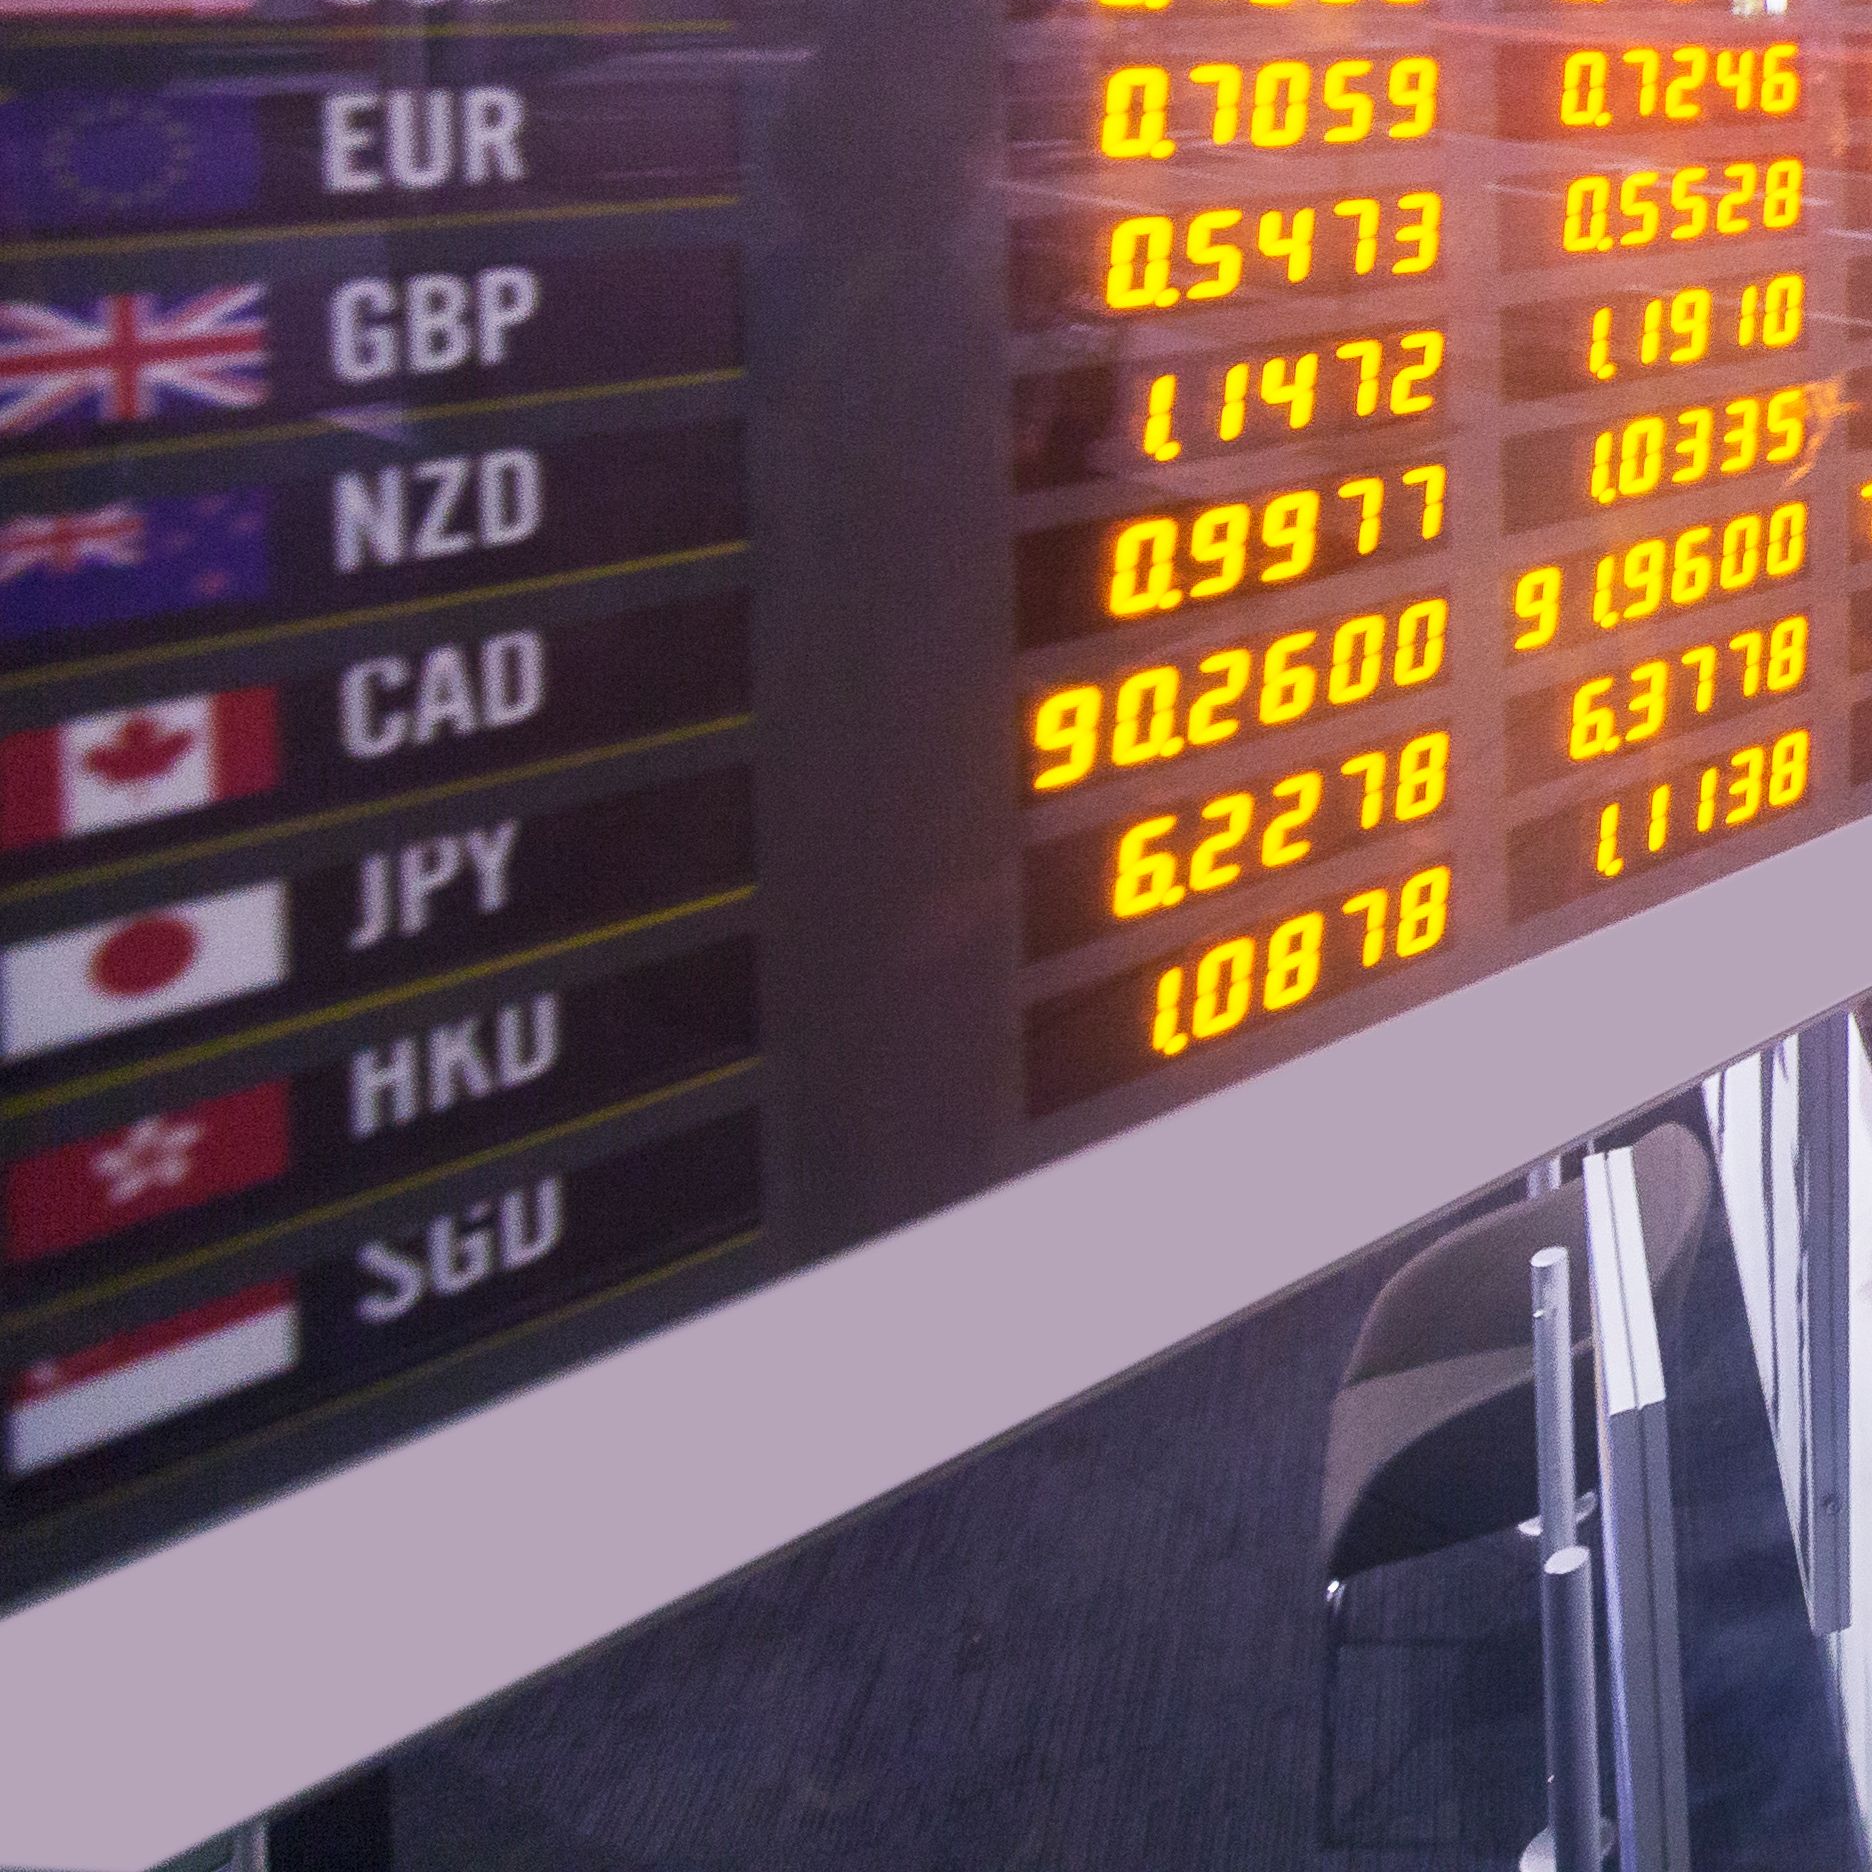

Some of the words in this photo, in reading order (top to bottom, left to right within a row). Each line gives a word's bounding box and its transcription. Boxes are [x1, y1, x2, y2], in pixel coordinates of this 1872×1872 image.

[322, 85, 525, 192] EUR
[1099, 56, 1439, 160] 0.7059
[1559, 43, 1799, 129] 0.7246
[329, 266, 540, 383] GBP
[1105, 191, 1442, 310] 0.5473
[1562, 158, 1804, 253] 0.5528
[333, 447, 542, 571] NZD
[1142, 330, 1445, 463] 1.1472
[1588, 273, 1805, 381] 1.1910
[340, 630, 545, 759] CAD
[1108, 464, 1447, 616] 0.9977
[1589, 387, 1806, 505] 1.0335
[350, 820, 518, 950] JPY
[1033, 598, 1448, 790] 90.2600
[1112, 731, 1450, 918] 6.2278
[1568, 615, 1808, 761] 6.3778
[1152, 866, 1450, 1056] 1.0878
[1595, 729, 1810, 878] 1.1138
